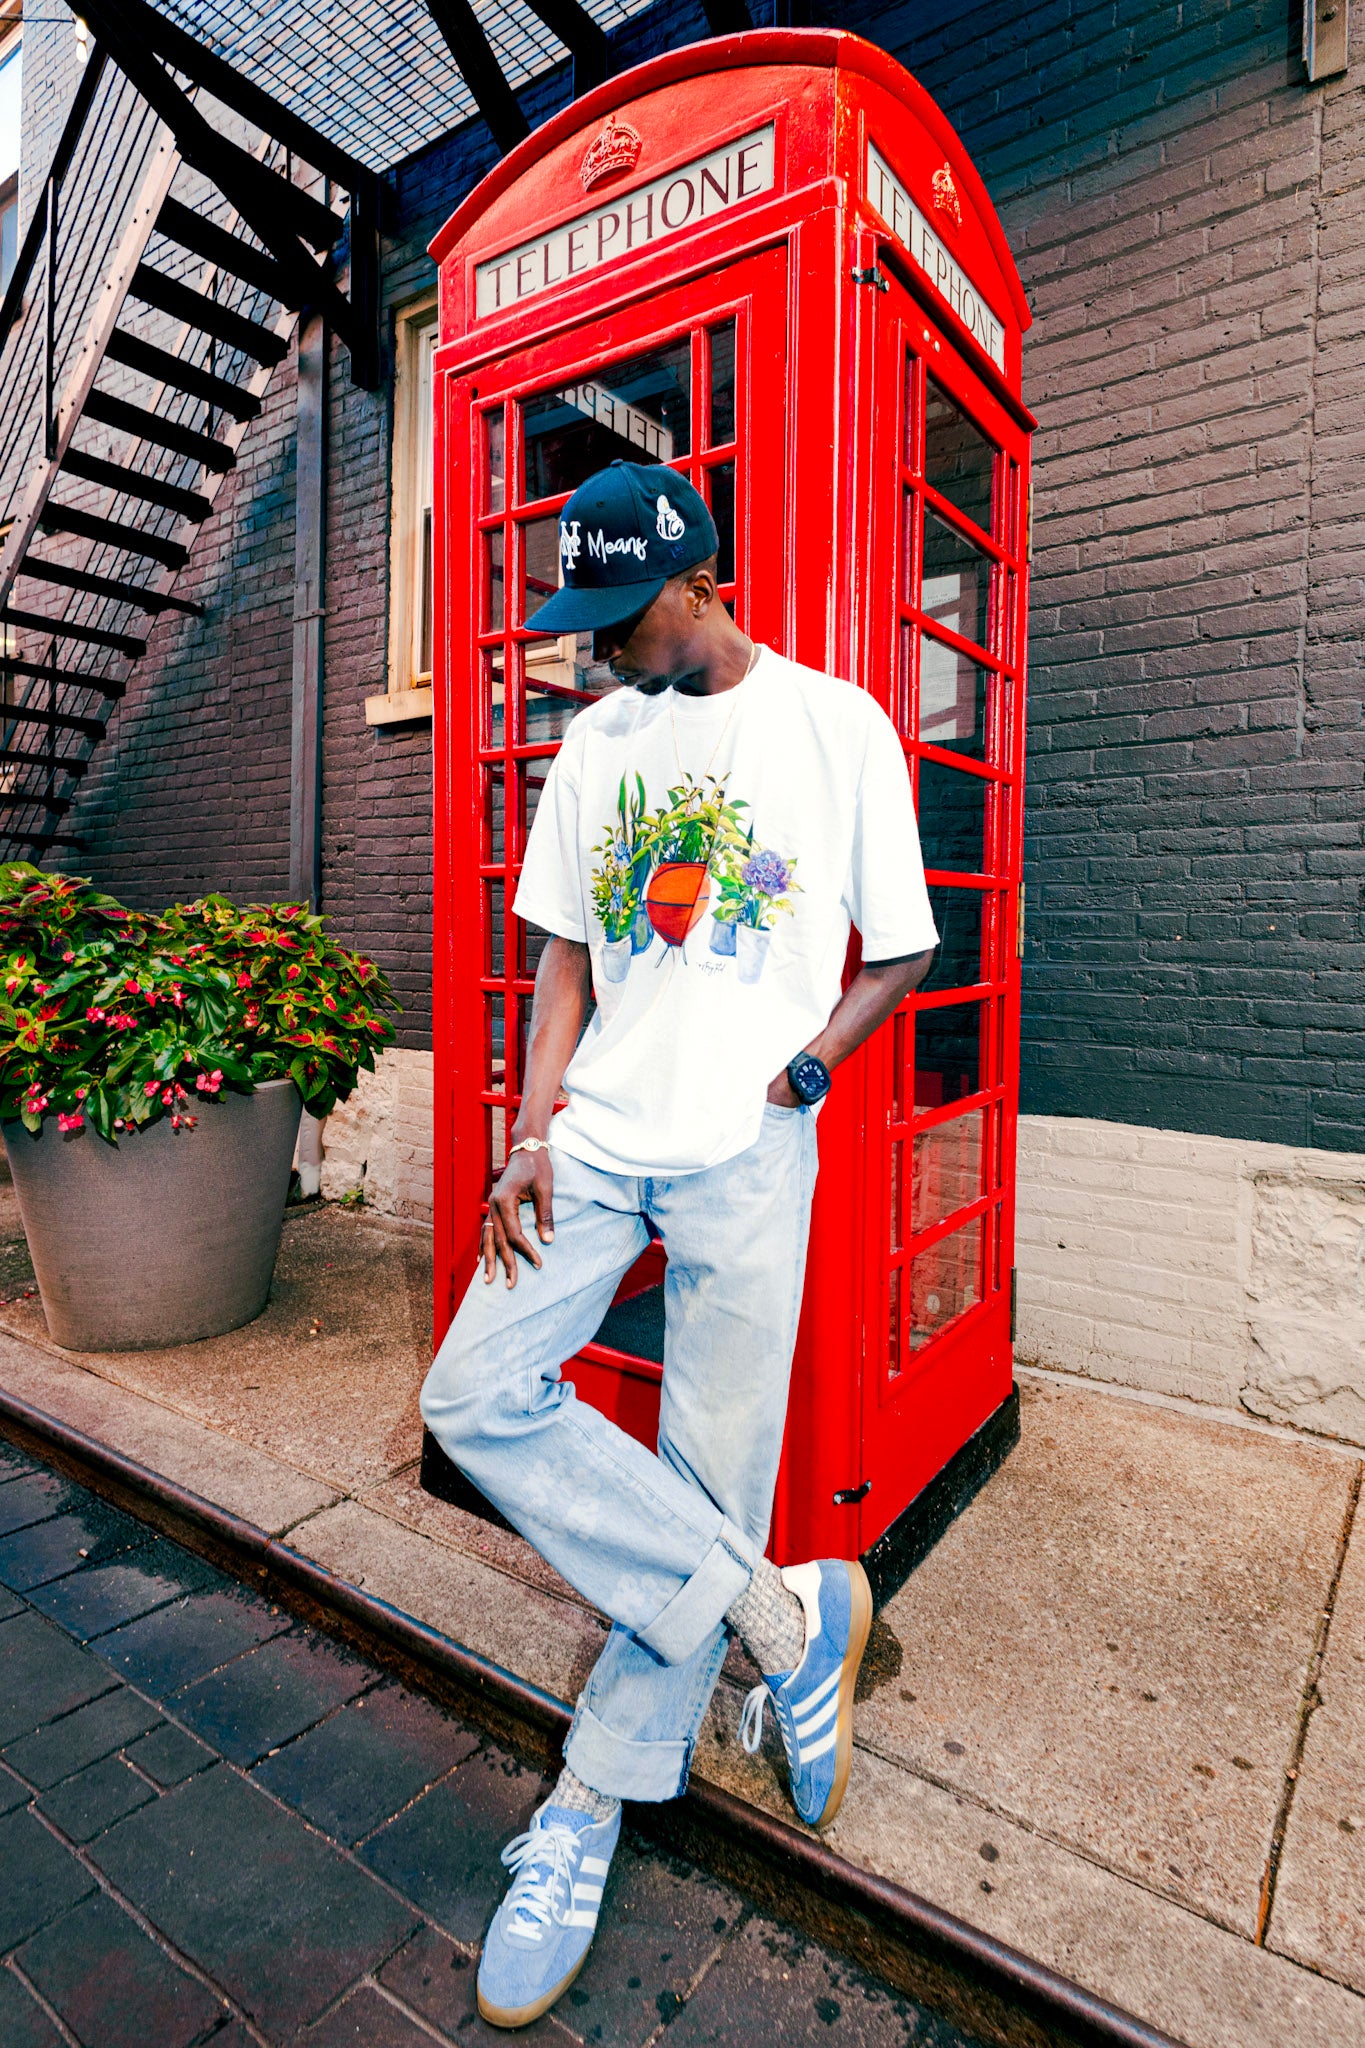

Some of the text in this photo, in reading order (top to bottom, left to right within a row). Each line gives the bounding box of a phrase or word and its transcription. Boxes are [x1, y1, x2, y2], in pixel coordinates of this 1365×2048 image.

[487, 141, 763, 307] TELEPHONE
[873, 159, 998, 358] TELEPHONE
[587, 528, 648, 564] Means
